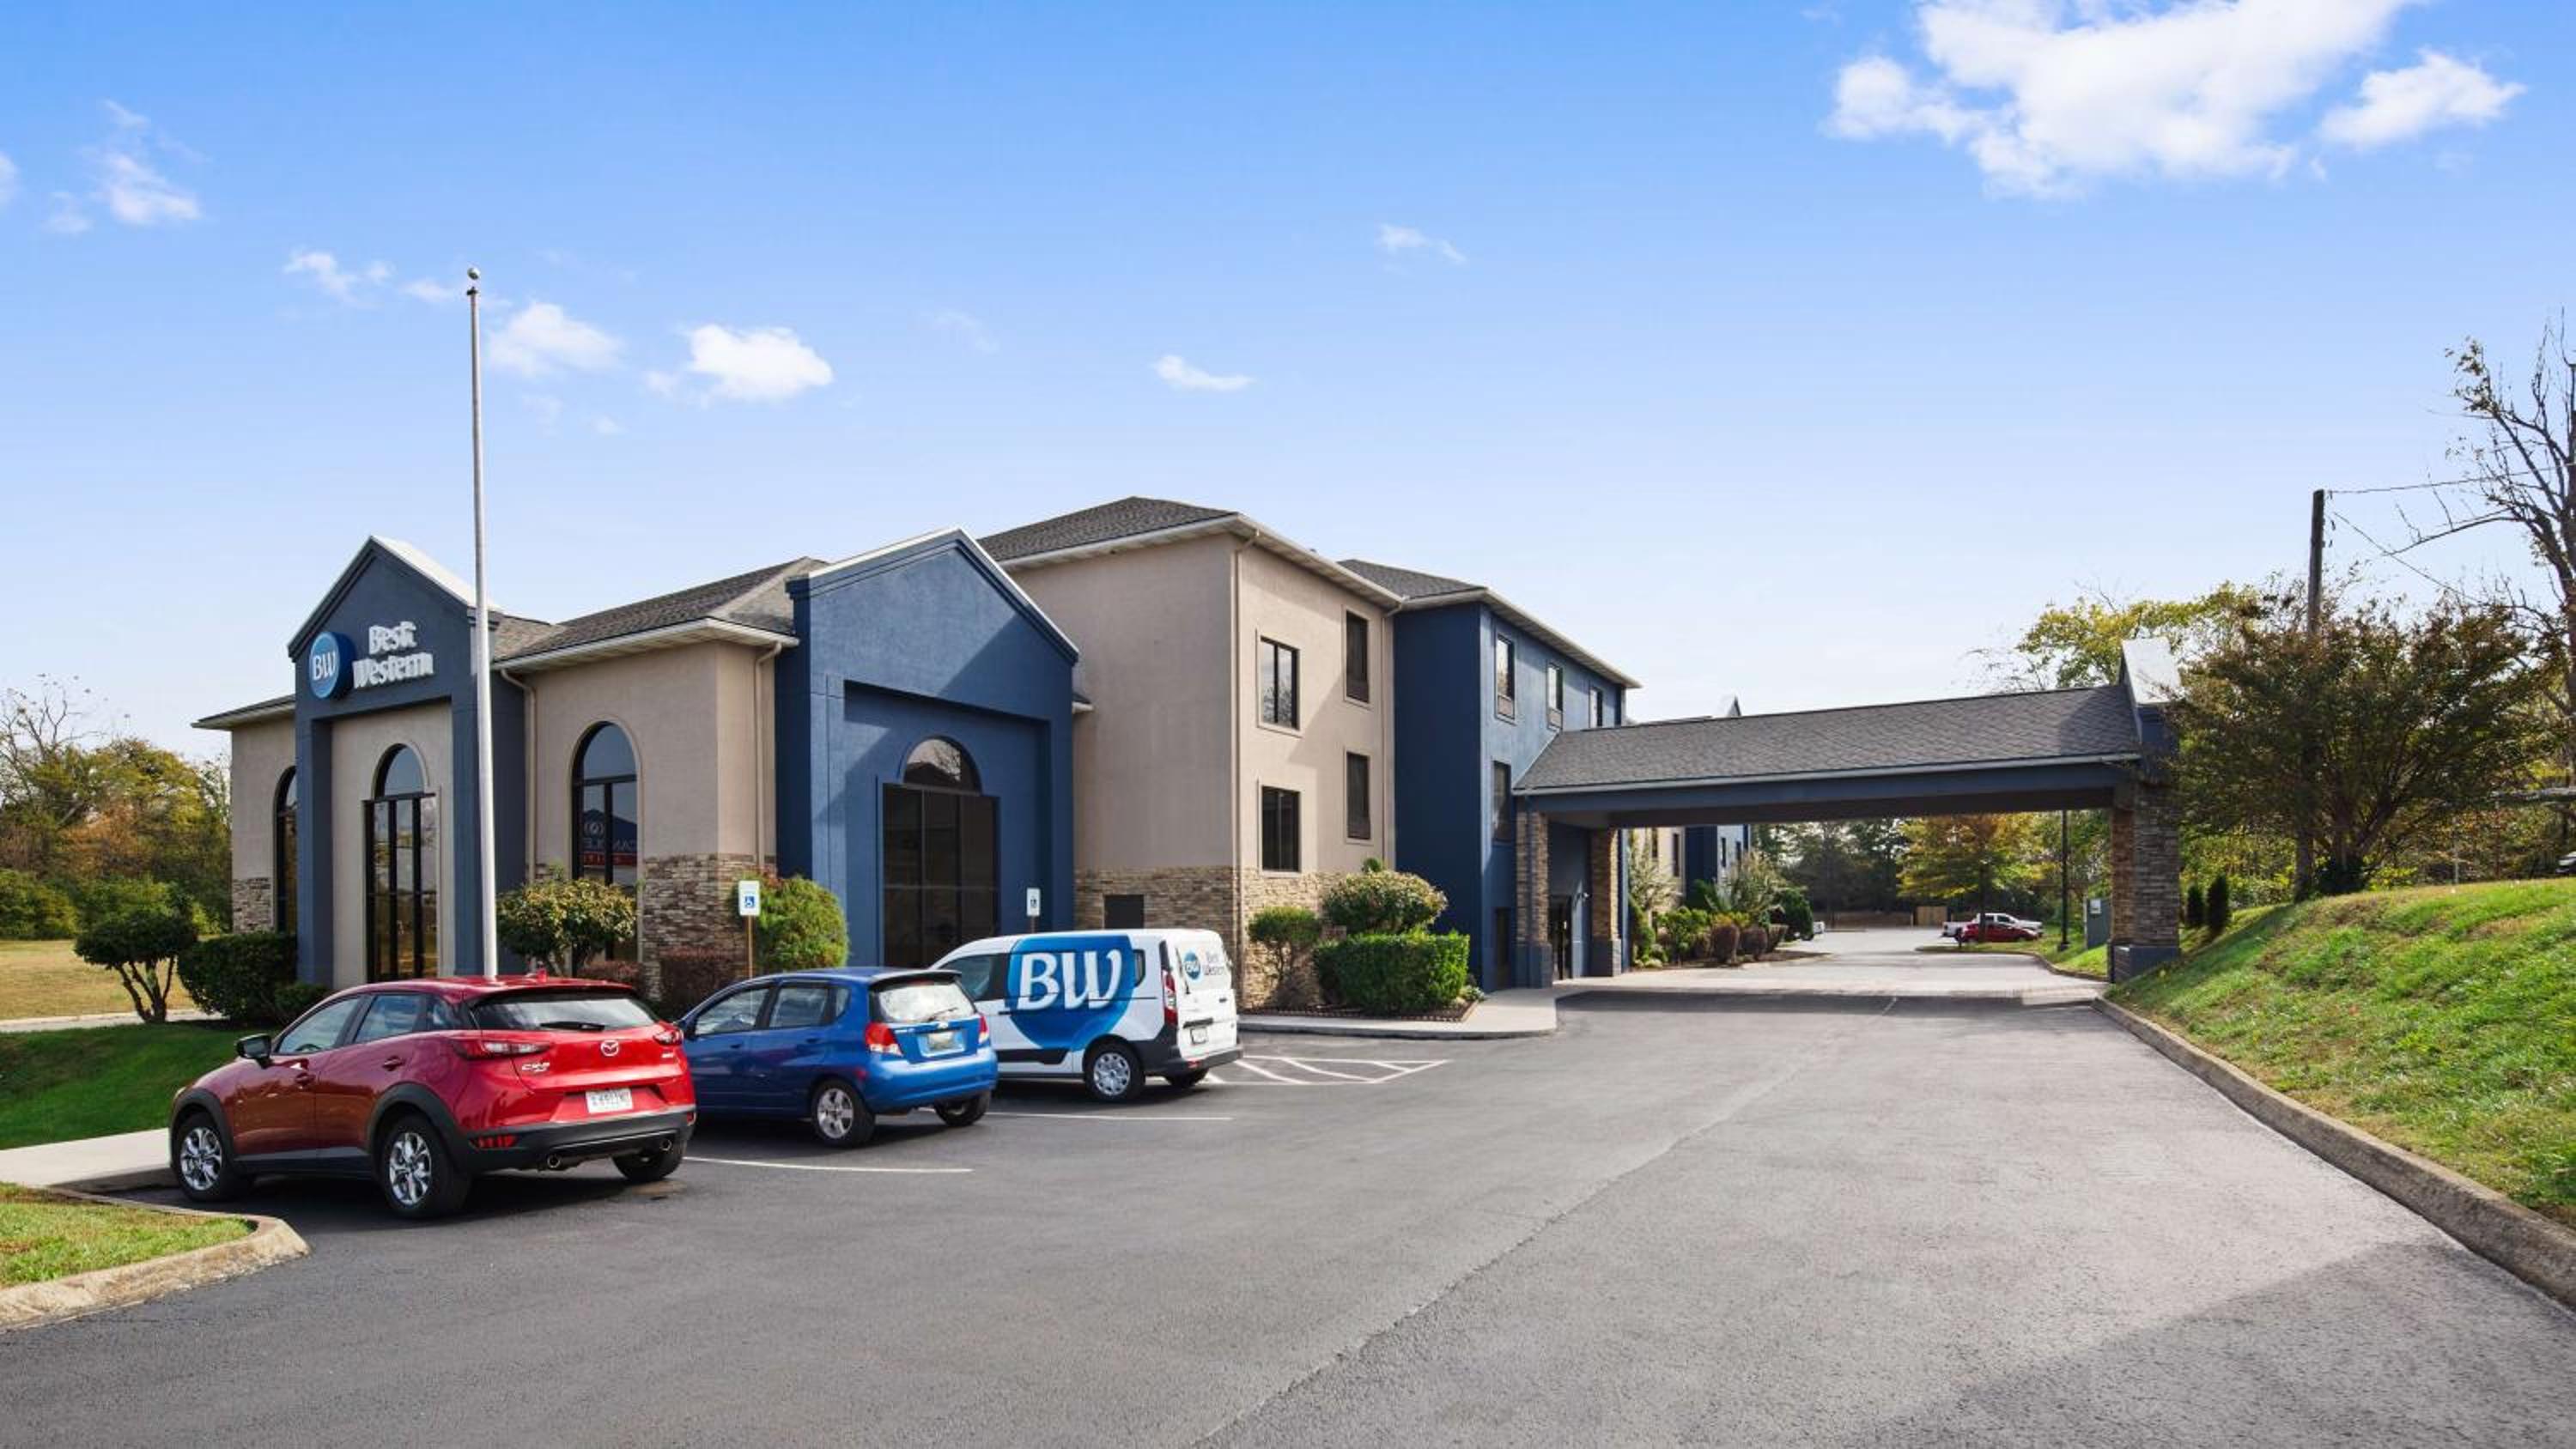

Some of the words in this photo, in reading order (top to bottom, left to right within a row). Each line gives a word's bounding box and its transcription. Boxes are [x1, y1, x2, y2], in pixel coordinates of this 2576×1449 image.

[369, 621, 417, 655] Best
[313, 652, 337, 681] BW
[353, 652, 434, 688] Western
[1018, 949, 1122, 1009] BW
